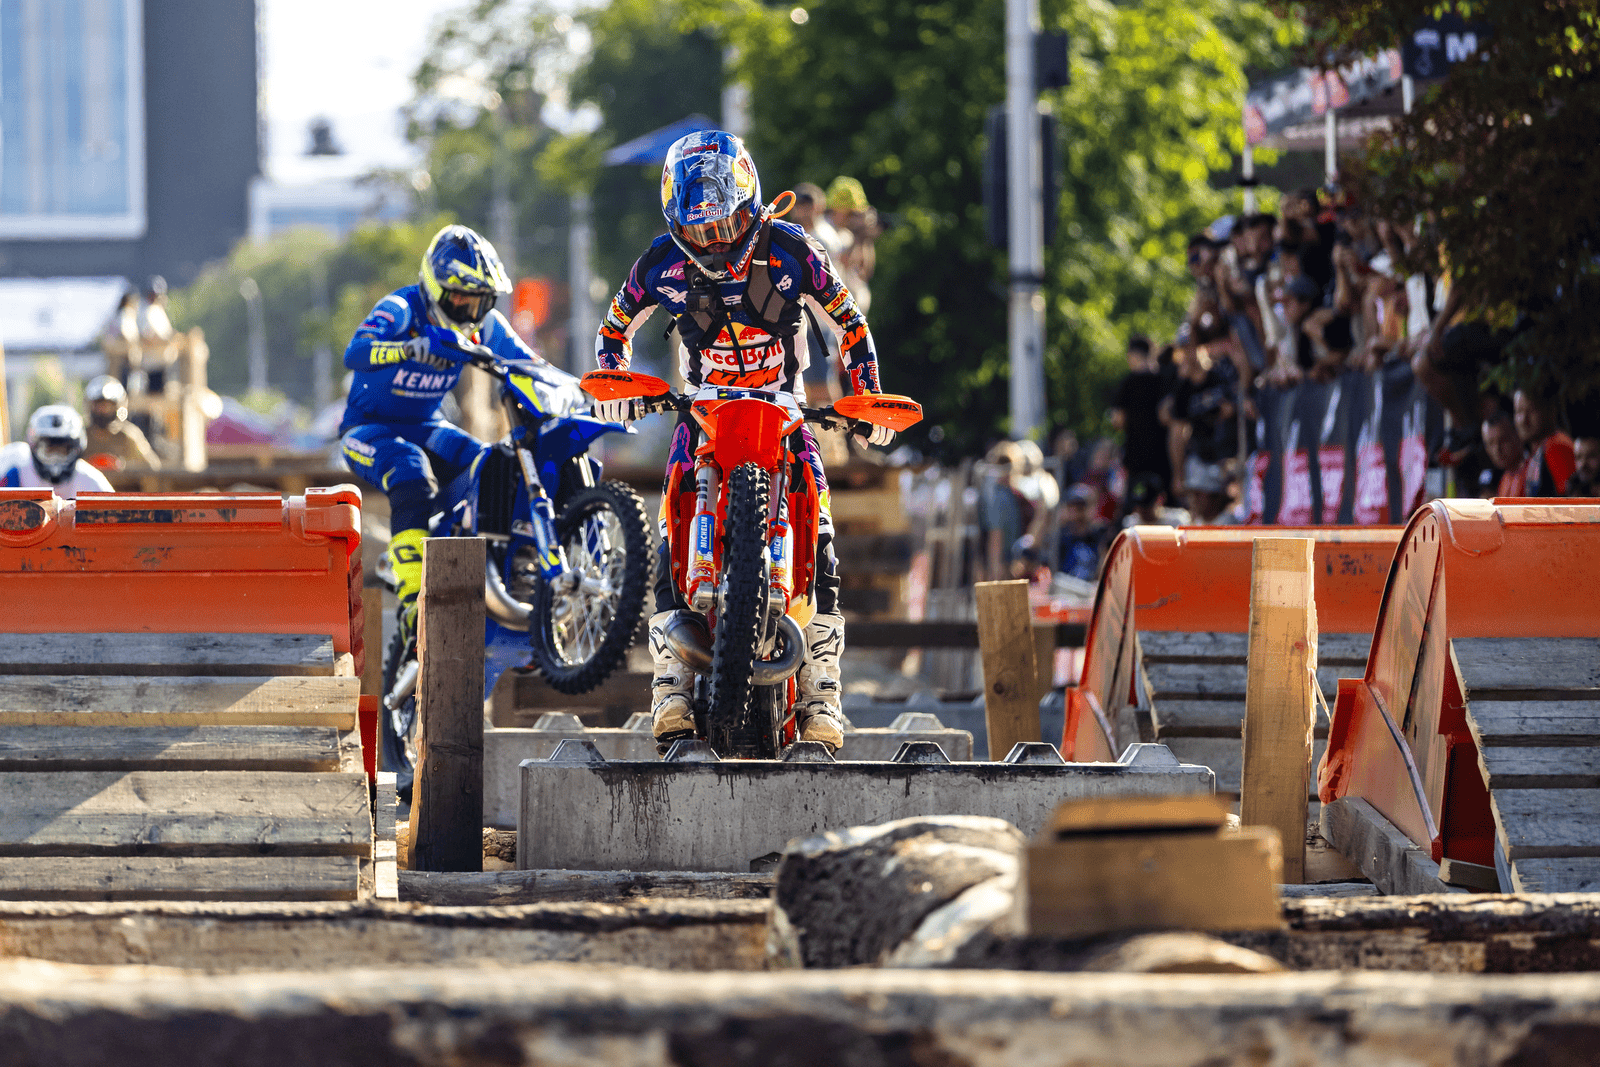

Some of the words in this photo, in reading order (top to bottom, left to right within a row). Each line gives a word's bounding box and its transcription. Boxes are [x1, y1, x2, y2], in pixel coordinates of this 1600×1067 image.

[687, 212, 704, 221] Red
[706, 209, 722, 217] Bull
[701, 348, 740, 367] Red
[742, 340, 782, 365] Bull
[392, 369, 457, 389] KENNY
[586, 374, 633, 382] ACERBIS
[704, 363, 782, 389] KTM
[872, 402, 919, 412] ACERBIS
[700, 516, 708, 549] MICHELIN
[773, 536, 782, 556] MICH
